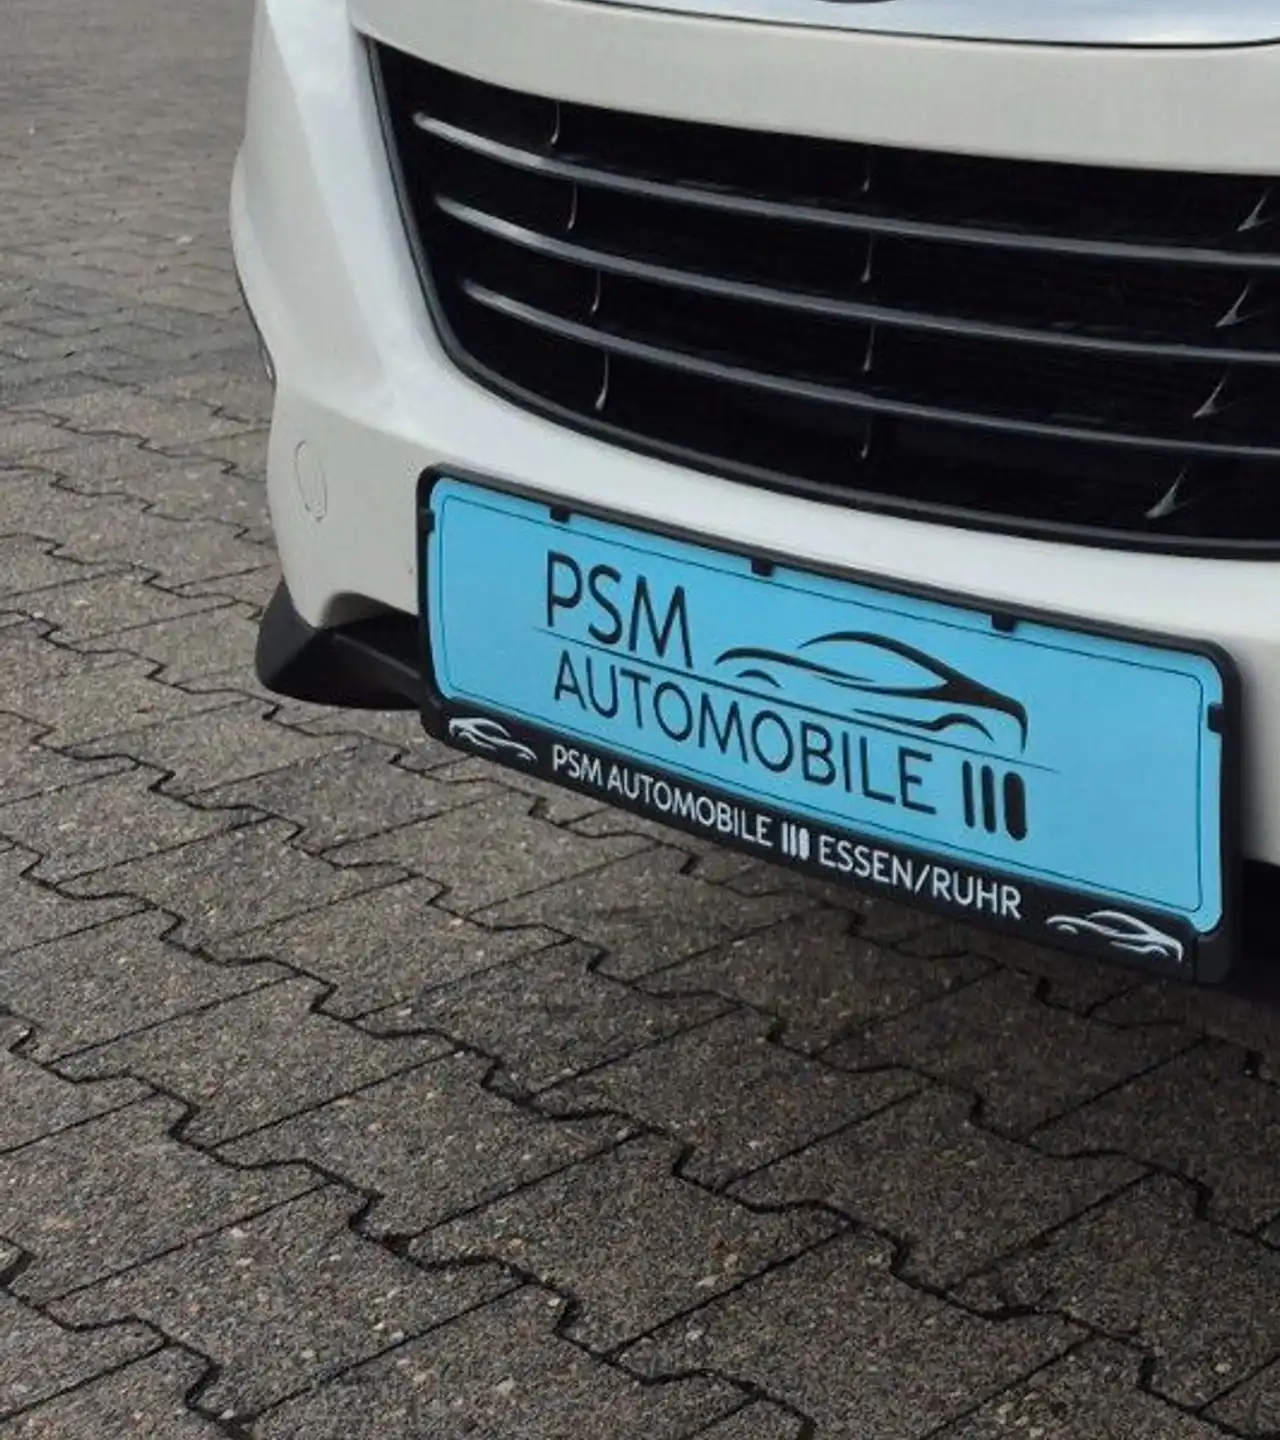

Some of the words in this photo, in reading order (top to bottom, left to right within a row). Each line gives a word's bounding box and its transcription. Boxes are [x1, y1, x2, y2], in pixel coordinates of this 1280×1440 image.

[546, 549, 693, 668] PSM
[554, 649, 936, 814] AUTOMOBILE
[552, 743, 604, 787] PSM
[606, 763, 773, 848] AUTOMOBILE
[818, 834, 1023, 921] ESSEN/RUHR
